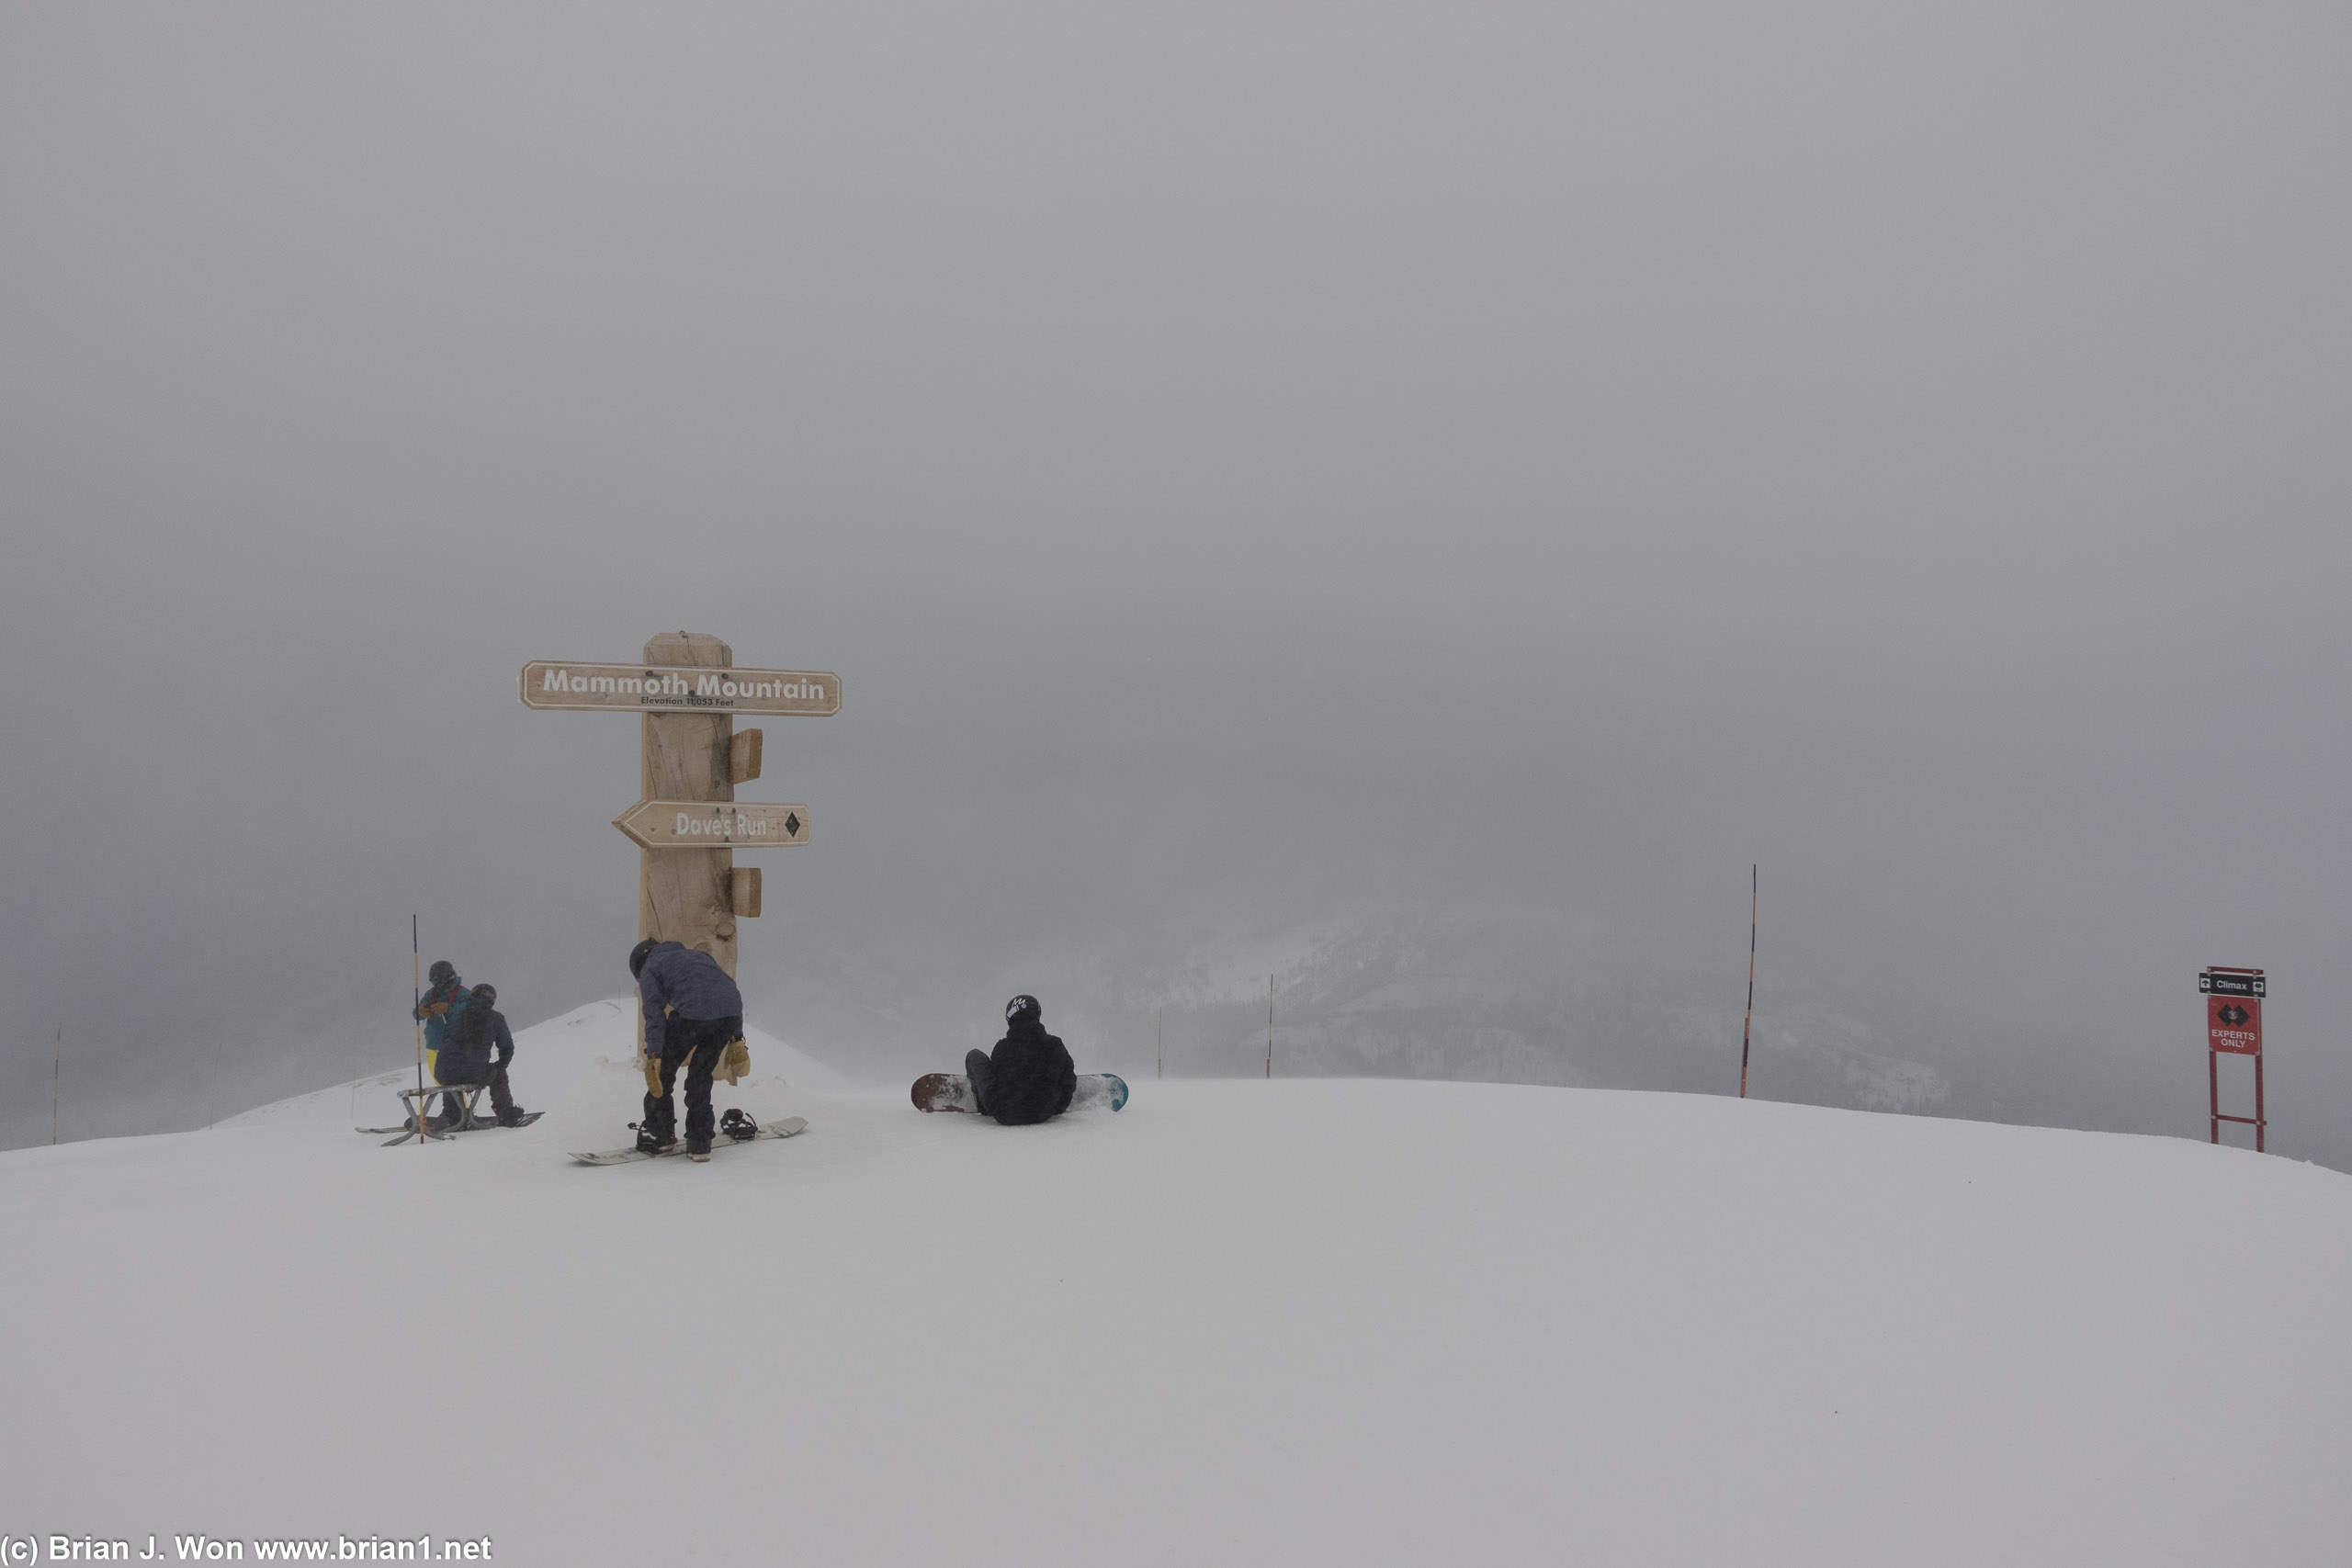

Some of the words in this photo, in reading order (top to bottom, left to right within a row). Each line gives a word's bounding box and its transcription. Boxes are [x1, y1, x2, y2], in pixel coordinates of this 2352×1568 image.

[542, 669, 689, 696] Mammoth
[695, 673, 825, 700] Mountain
[640, 696, 683, 705] Elevation
[686, 697, 713, 706] 11,053
[715, 698, 734, 706] Feet
[676, 812, 731, 836] Dave's
[737, 814, 767, 836] Run
[2216, 980, 2247, 990] Climax
[2211, 1029, 2256, 1041] EXPERTS
[2221, 1038, 2246, 1048] ONLY
